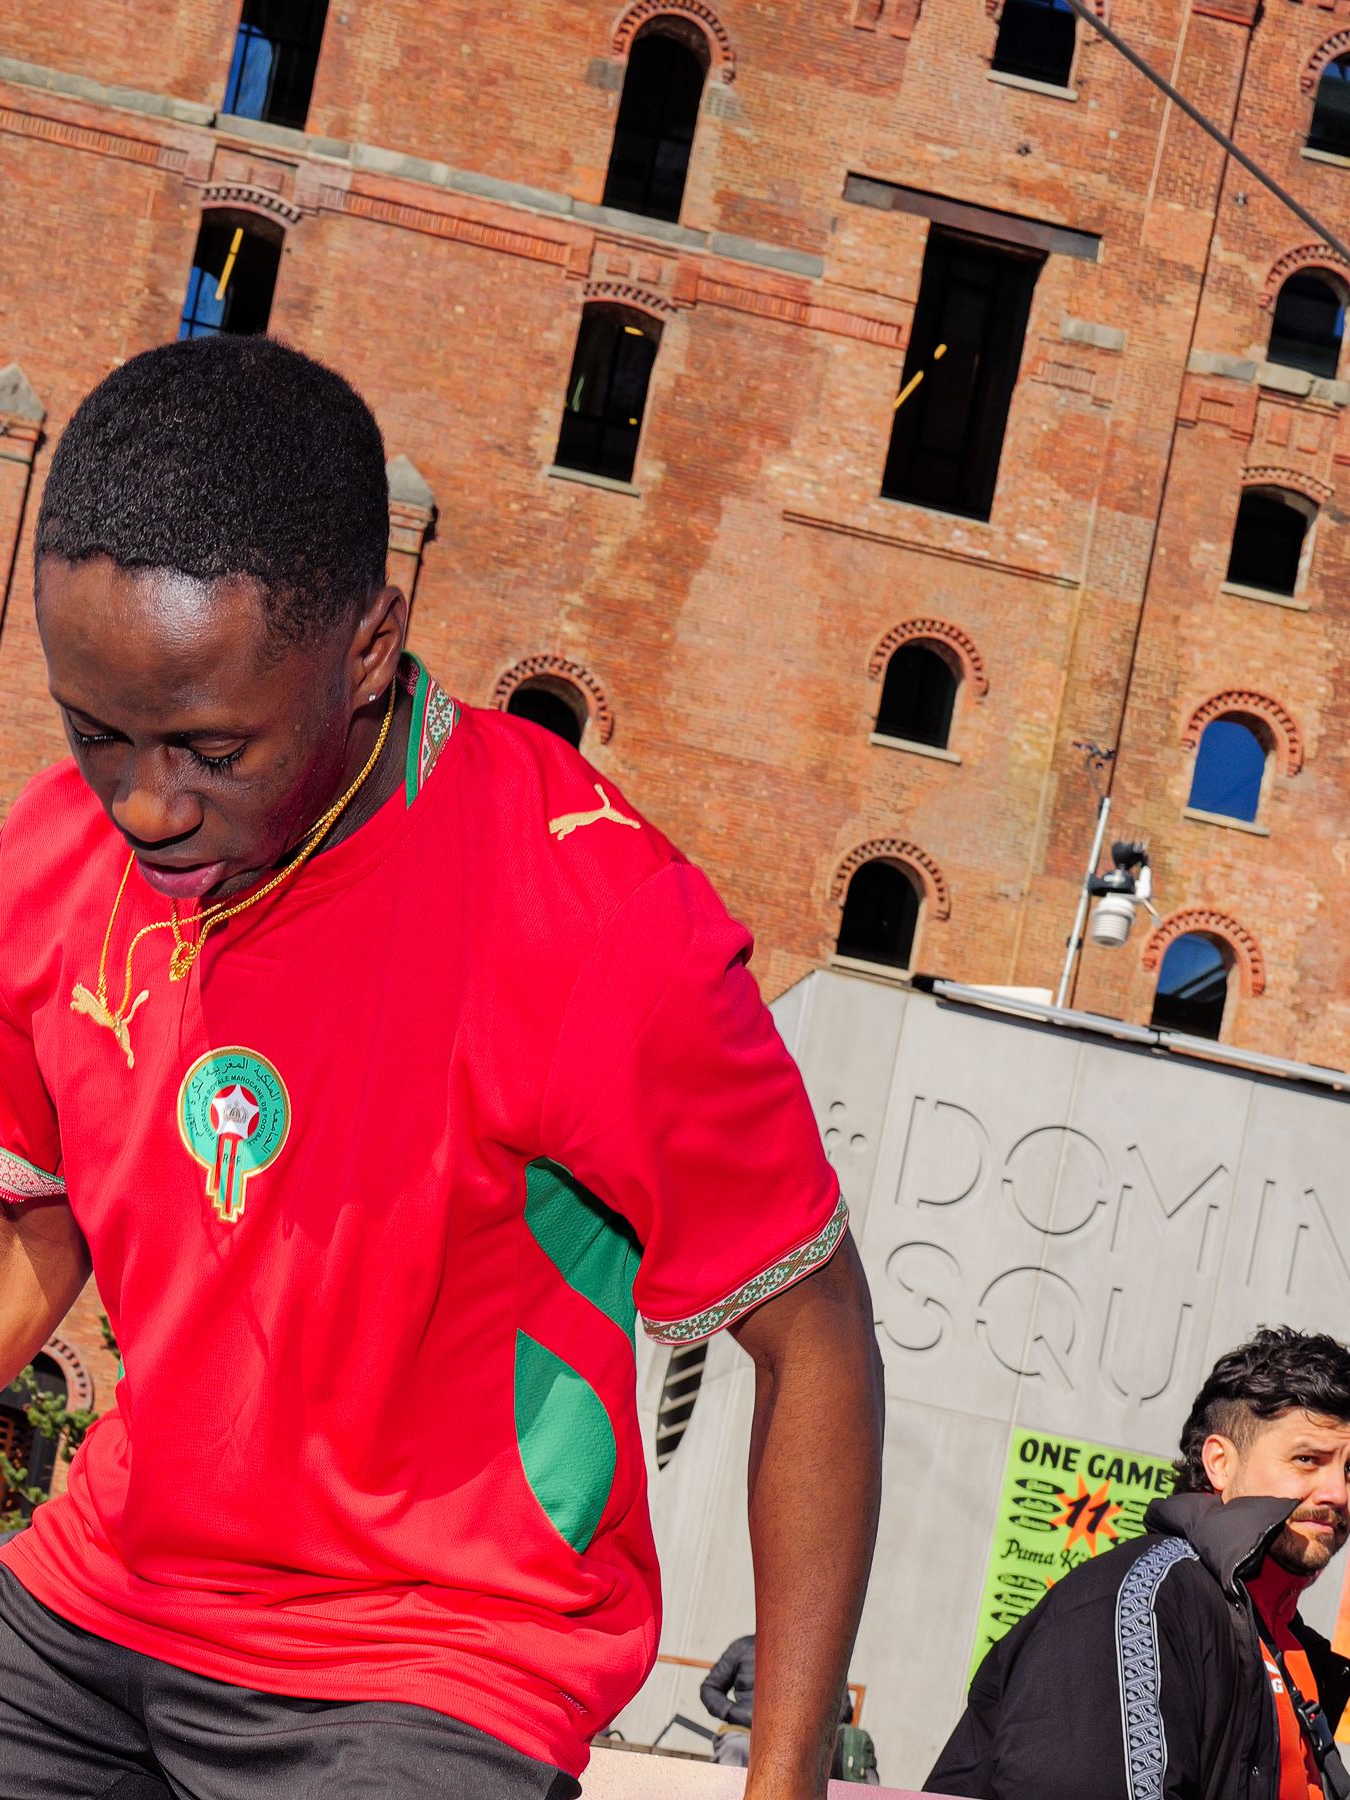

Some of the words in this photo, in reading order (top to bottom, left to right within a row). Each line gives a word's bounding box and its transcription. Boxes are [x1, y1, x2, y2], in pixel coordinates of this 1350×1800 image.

[231, 1074, 265, 1101] MAROCAINE
[874, 1240, 1198, 1407] SQU
[1019, 1438, 1081, 1472] ONE
[1066, 1493, 1112, 1535] 11
